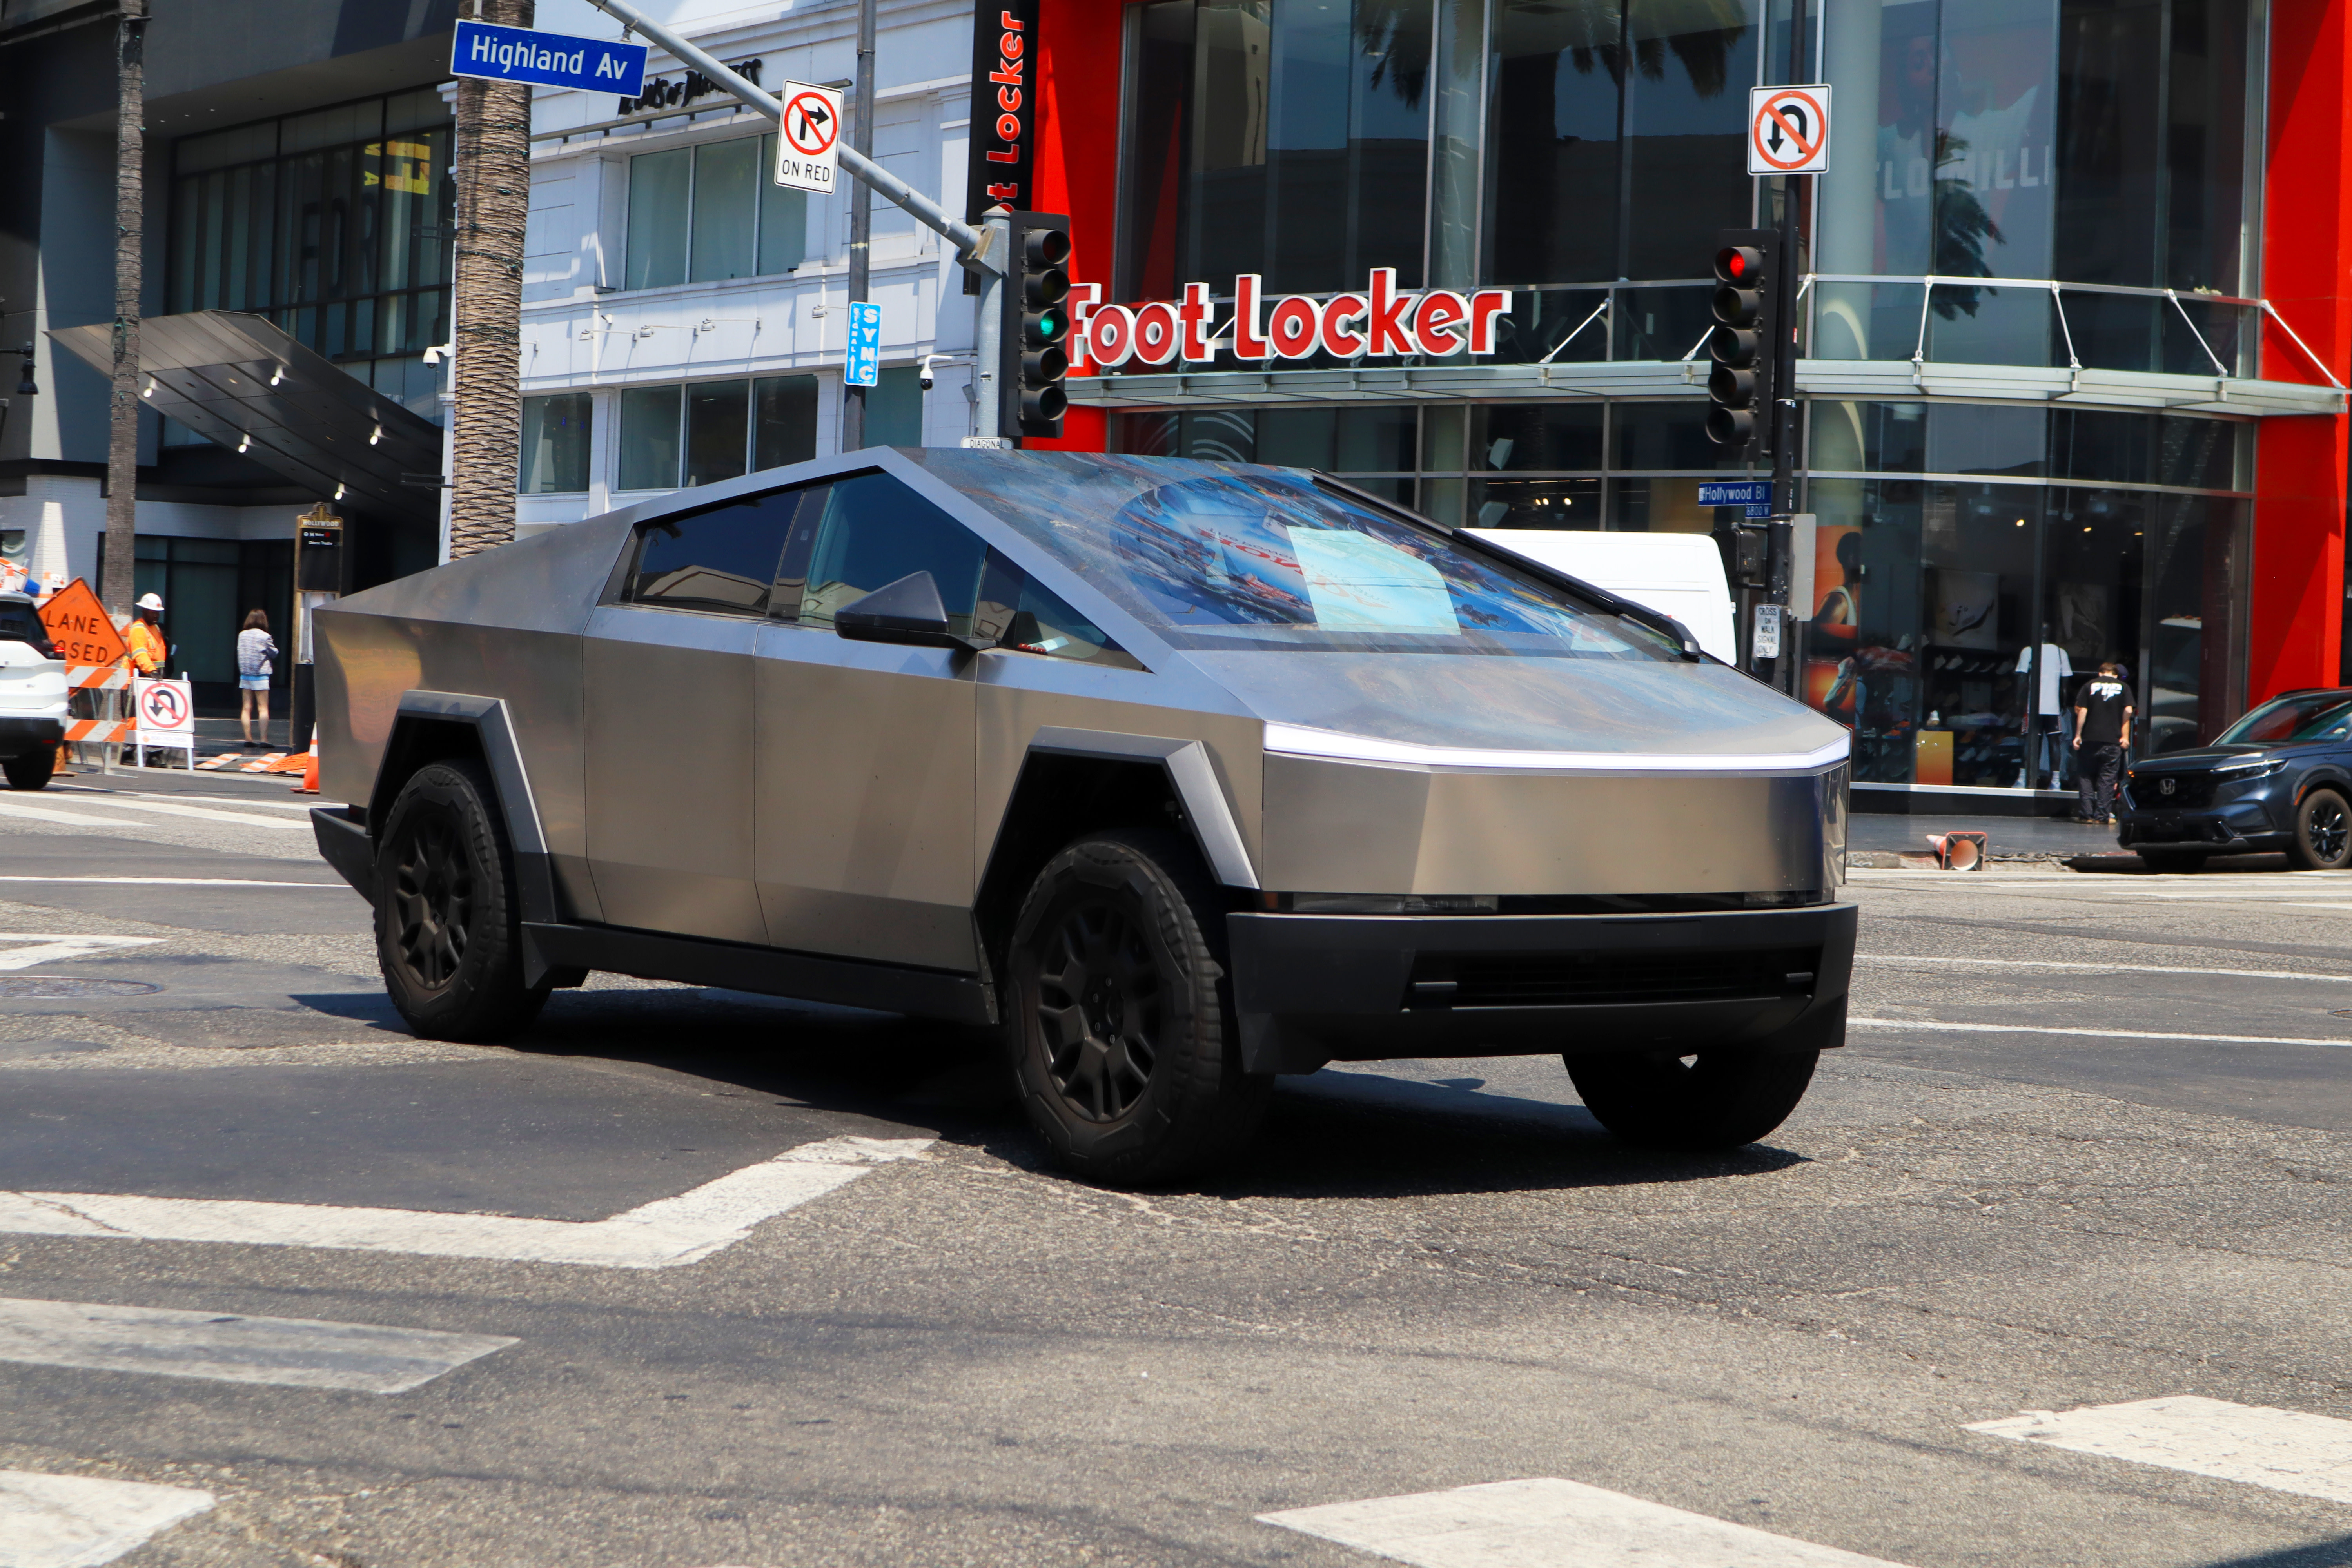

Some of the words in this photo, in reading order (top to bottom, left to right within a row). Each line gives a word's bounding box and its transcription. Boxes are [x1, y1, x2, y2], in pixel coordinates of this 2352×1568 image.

[471, 34, 584, 74] Highland
[595, 52, 628, 80] Av
[986, 10, 1025, 164] Locker
[782, 159, 800, 177] ON
[805, 163, 830, 182] RED
[1068, 282, 1215, 367] Foot
[1233, 267, 1512, 361] Locker
[850, 307, 860, 352] SIGNAL
[859, 308, 878, 381] SYNC
[970, 439, 1004, 449] DIAGONAL
[1704, 486, 1752, 504] Hollywood
[1755, 485, 1765, 499] Bl
[45, 610, 99, 635] LANE
[1758, 607, 1777, 616] CROSS
[56, 639, 108, 663] OSED
[1757, 635, 1777, 644] SIGNAL
